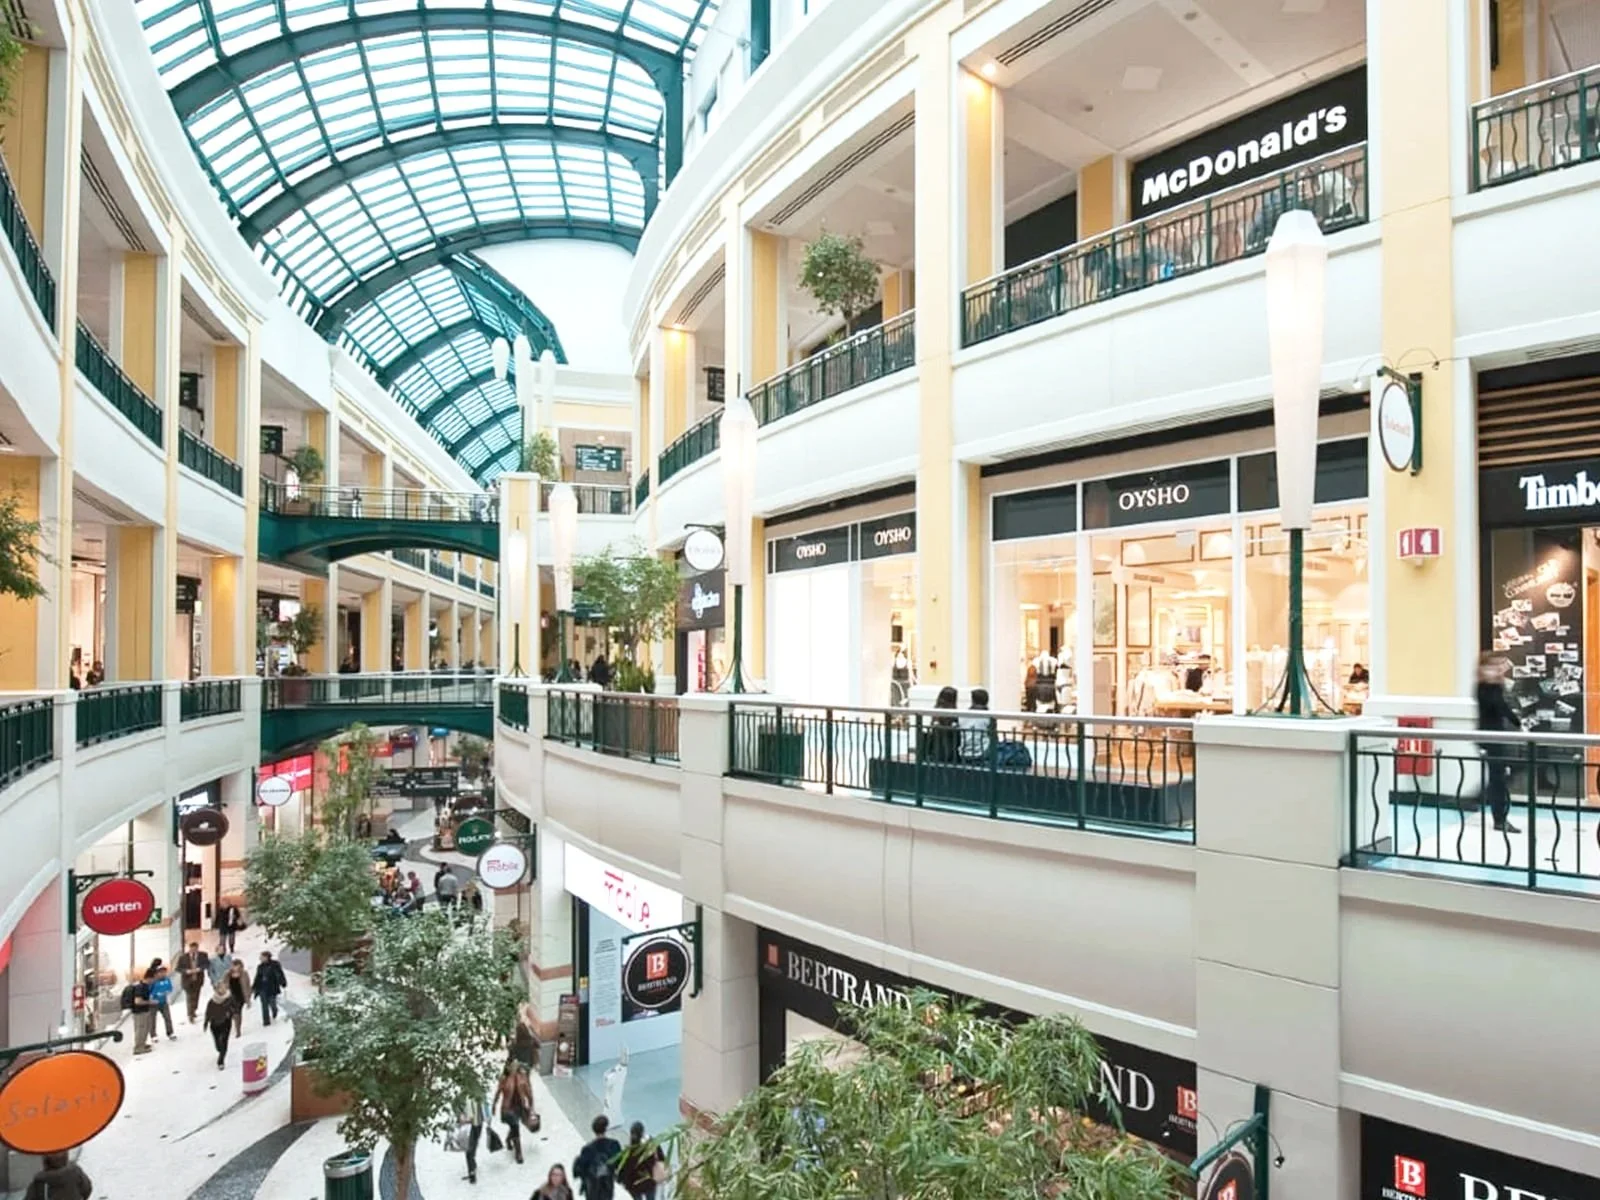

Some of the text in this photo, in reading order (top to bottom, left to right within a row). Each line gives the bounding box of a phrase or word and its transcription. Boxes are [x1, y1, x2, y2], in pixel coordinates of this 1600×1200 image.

[1142, 105, 1347, 205] McDonald's
[1119, 484, 1190, 510] OYSHO
[1519, 470, 1600, 510] Timb
[874, 527, 912, 546] OYSHO
[796, 543, 826, 559] OYSHO
[92, 901, 142, 915] worten
[787, 951, 913, 1019] BERTRAND
[1402, 1160, 1422, 1186] B
